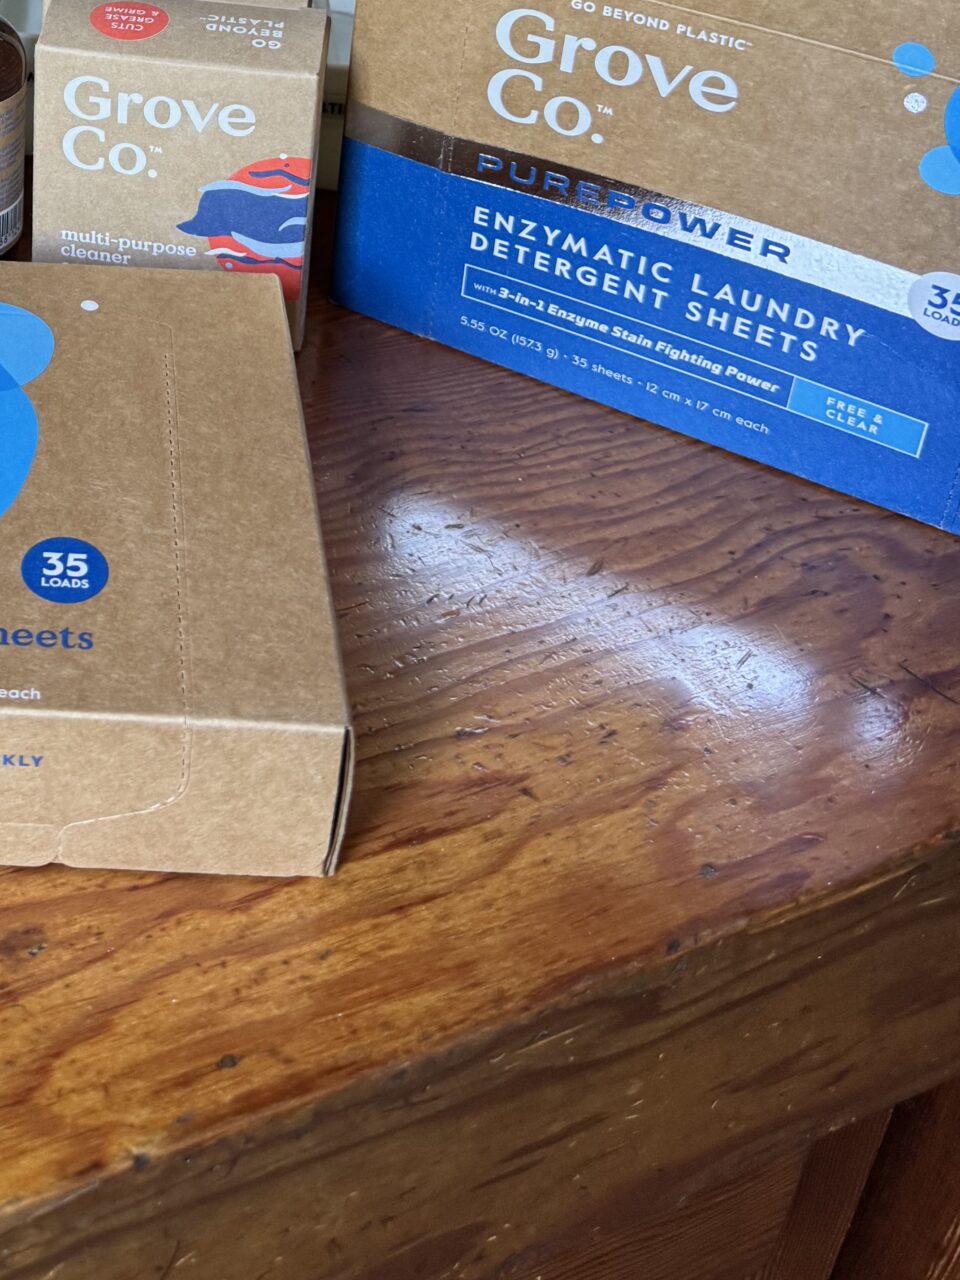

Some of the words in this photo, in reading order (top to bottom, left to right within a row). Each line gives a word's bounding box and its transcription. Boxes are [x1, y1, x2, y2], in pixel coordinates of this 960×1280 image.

[104, 6, 146, 16] GRIME
[104, 13, 155, 24] GREASE
[602, 4, 671, 32] BEYOND
[111, 21, 144, 32] CUTS
[205, 23, 283, 38] BEYOND
[251, 38, 281, 50] GO
[495, 8, 739, 113] Grove
[63, 75, 257, 137] Grove
[477, 152, 792, 265] PUREPOWER
[60, 230, 197, 257] multi-purpose
[60, 244, 132, 265] cleaner
[473, 206, 674, 284] ENZYMATIC
[691, 273, 866, 348] LAUNDRY
[470, 232, 670, 311] DETERGENT
[684, 301, 821, 363] SHEETS
[923, 307, 960, 328] LOAD
[473, 282, 497, 296] WITH
[498, 287, 545, 313] 3-in-1
[547, 303, 610, 334] Enzyme
[610, 325, 653, 349] Stain
[654, 340, 723, 376] Fighting
[724, 365, 781, 394] Power
[460, 315, 486, 332] 5.55
[489, 325, 509, 341] OZ
[546, 347, 560, 360] g)
[571, 354, 588, 369] 35
[591, 363, 633, 385] sheets
[645, 381, 659, 395] 12
[662, 389, 681, 403] cm
[684, 397, 692, 406] x
[695, 400, 709, 412] 17
[712, 407, 732, 421] cm
[735, 416, 770, 435] each
[825, 396, 867, 418] FREE
[873, 414, 883, 425] &
[825, 409, 879, 435] CLEAR
[42, 550, 89, 578] 35
[41, 576, 91, 590] LOADS
